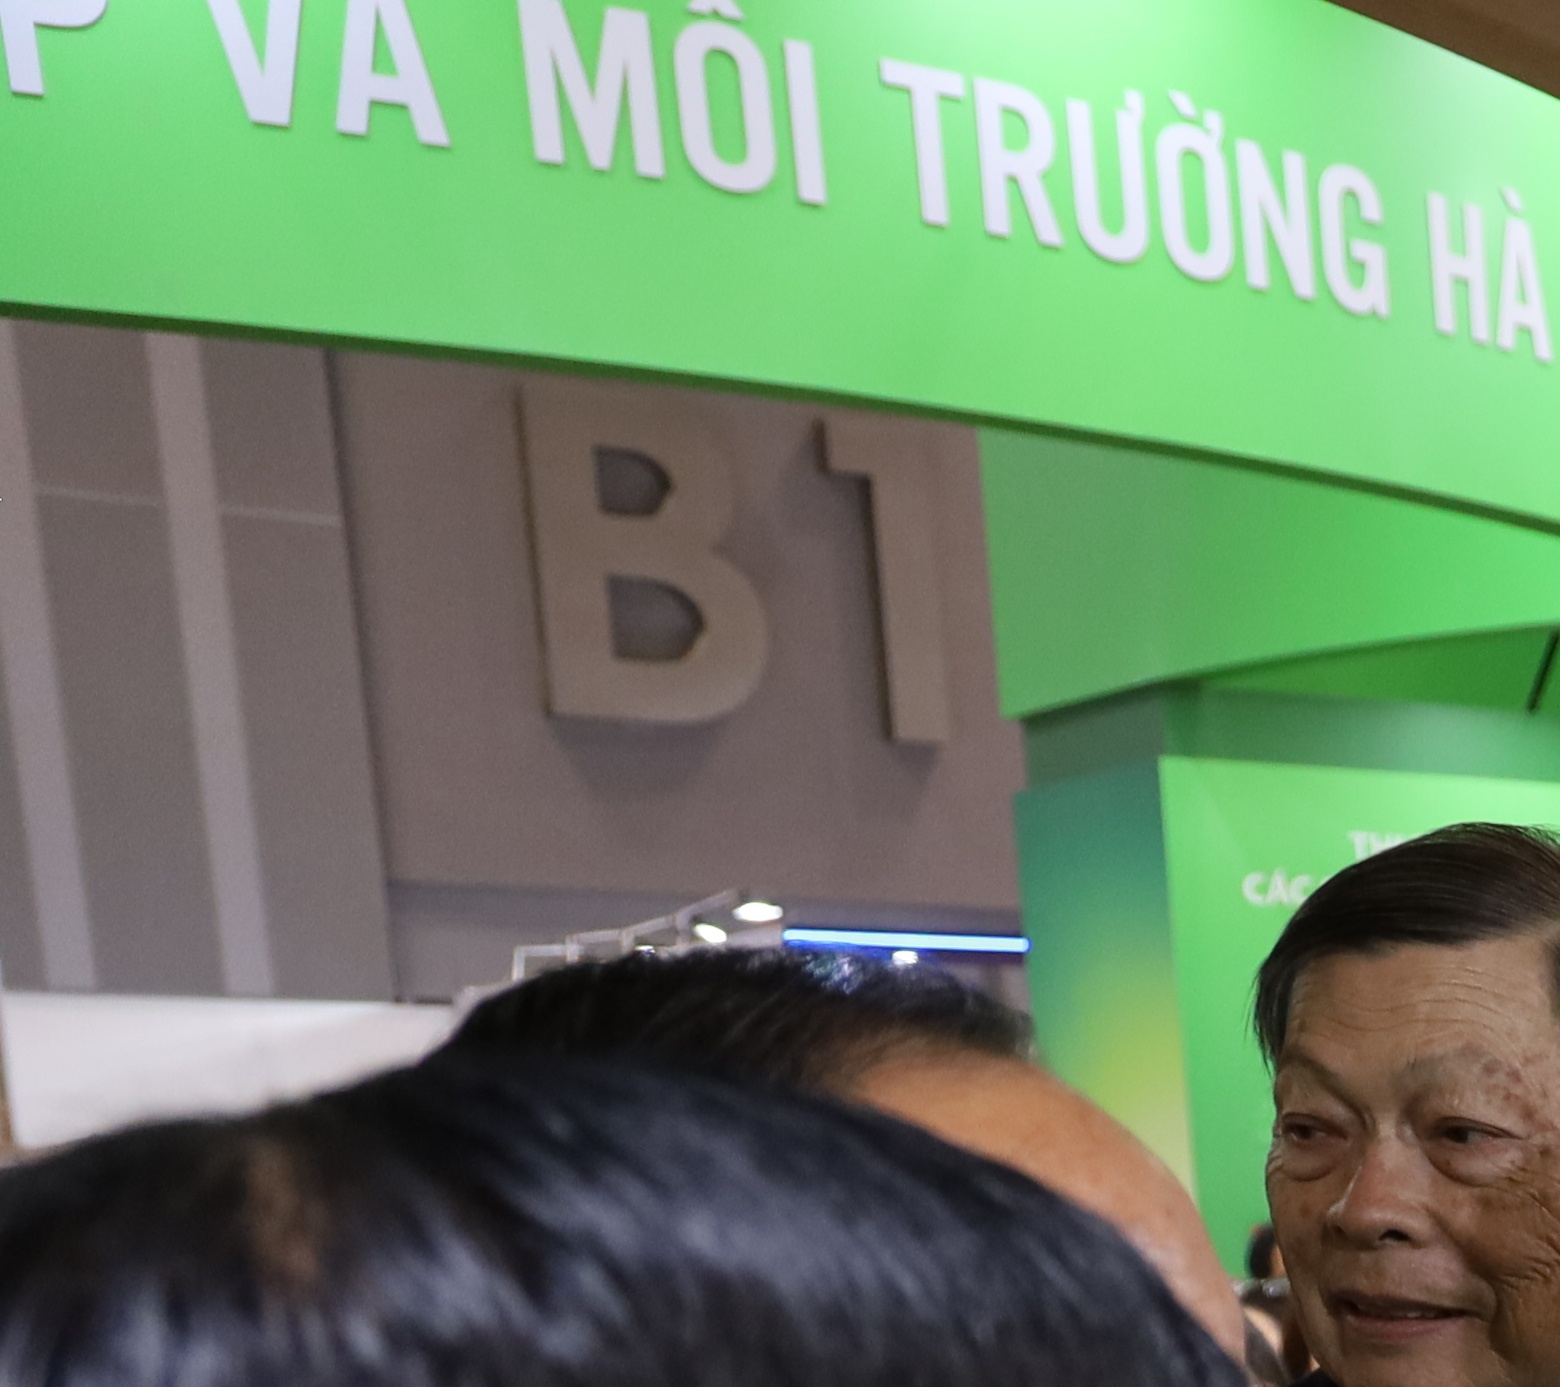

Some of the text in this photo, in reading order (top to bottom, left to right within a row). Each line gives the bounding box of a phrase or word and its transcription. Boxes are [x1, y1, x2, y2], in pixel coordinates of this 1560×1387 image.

[517, 0, 827, 205] MÔI
[878, 57, 1391, 319] TRƯỜNG
[1427, 185, 1554, 365] HÀ
[514, 384, 954, 745] B1
